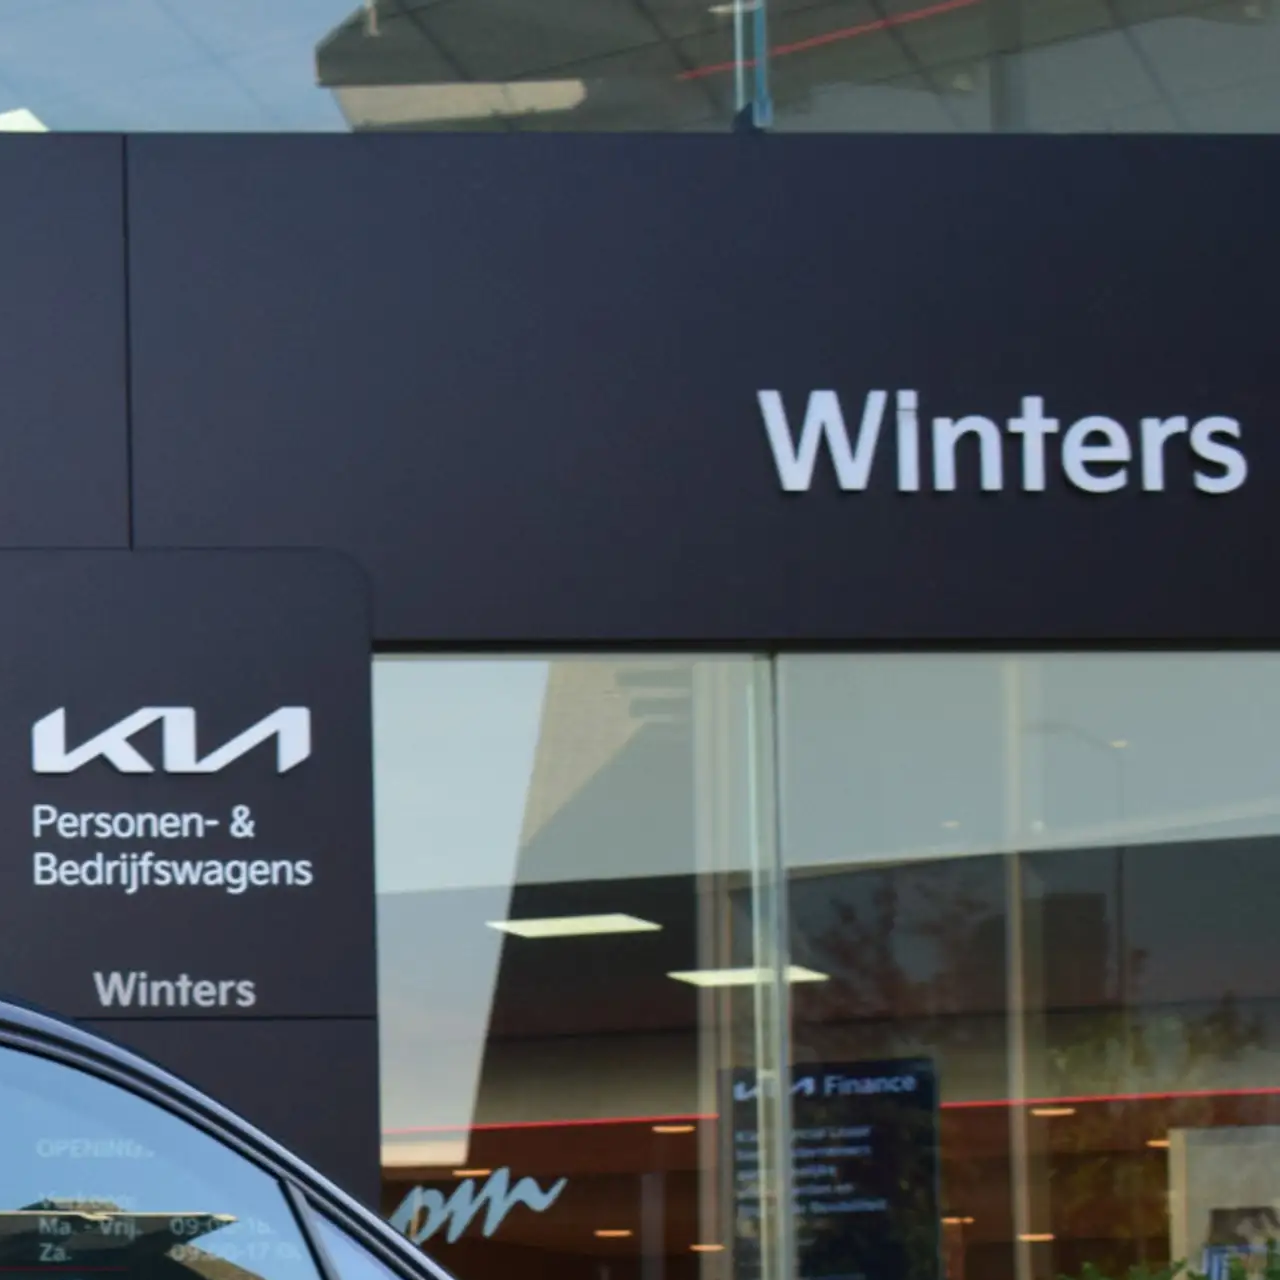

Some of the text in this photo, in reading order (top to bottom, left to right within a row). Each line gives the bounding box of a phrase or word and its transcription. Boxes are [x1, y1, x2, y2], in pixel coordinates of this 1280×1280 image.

[757, 389, 1248, 494] Winters
[32, 706, 311, 774] KIA
[32, 804, 256, 839] Personen- &
[32, 851, 314, 895] Bedrijfswagens
[92, 970, 257, 1008] Winters
[823, 1073, 918, 1096] Finance
[38, 1243, 72, 1262] Za.
